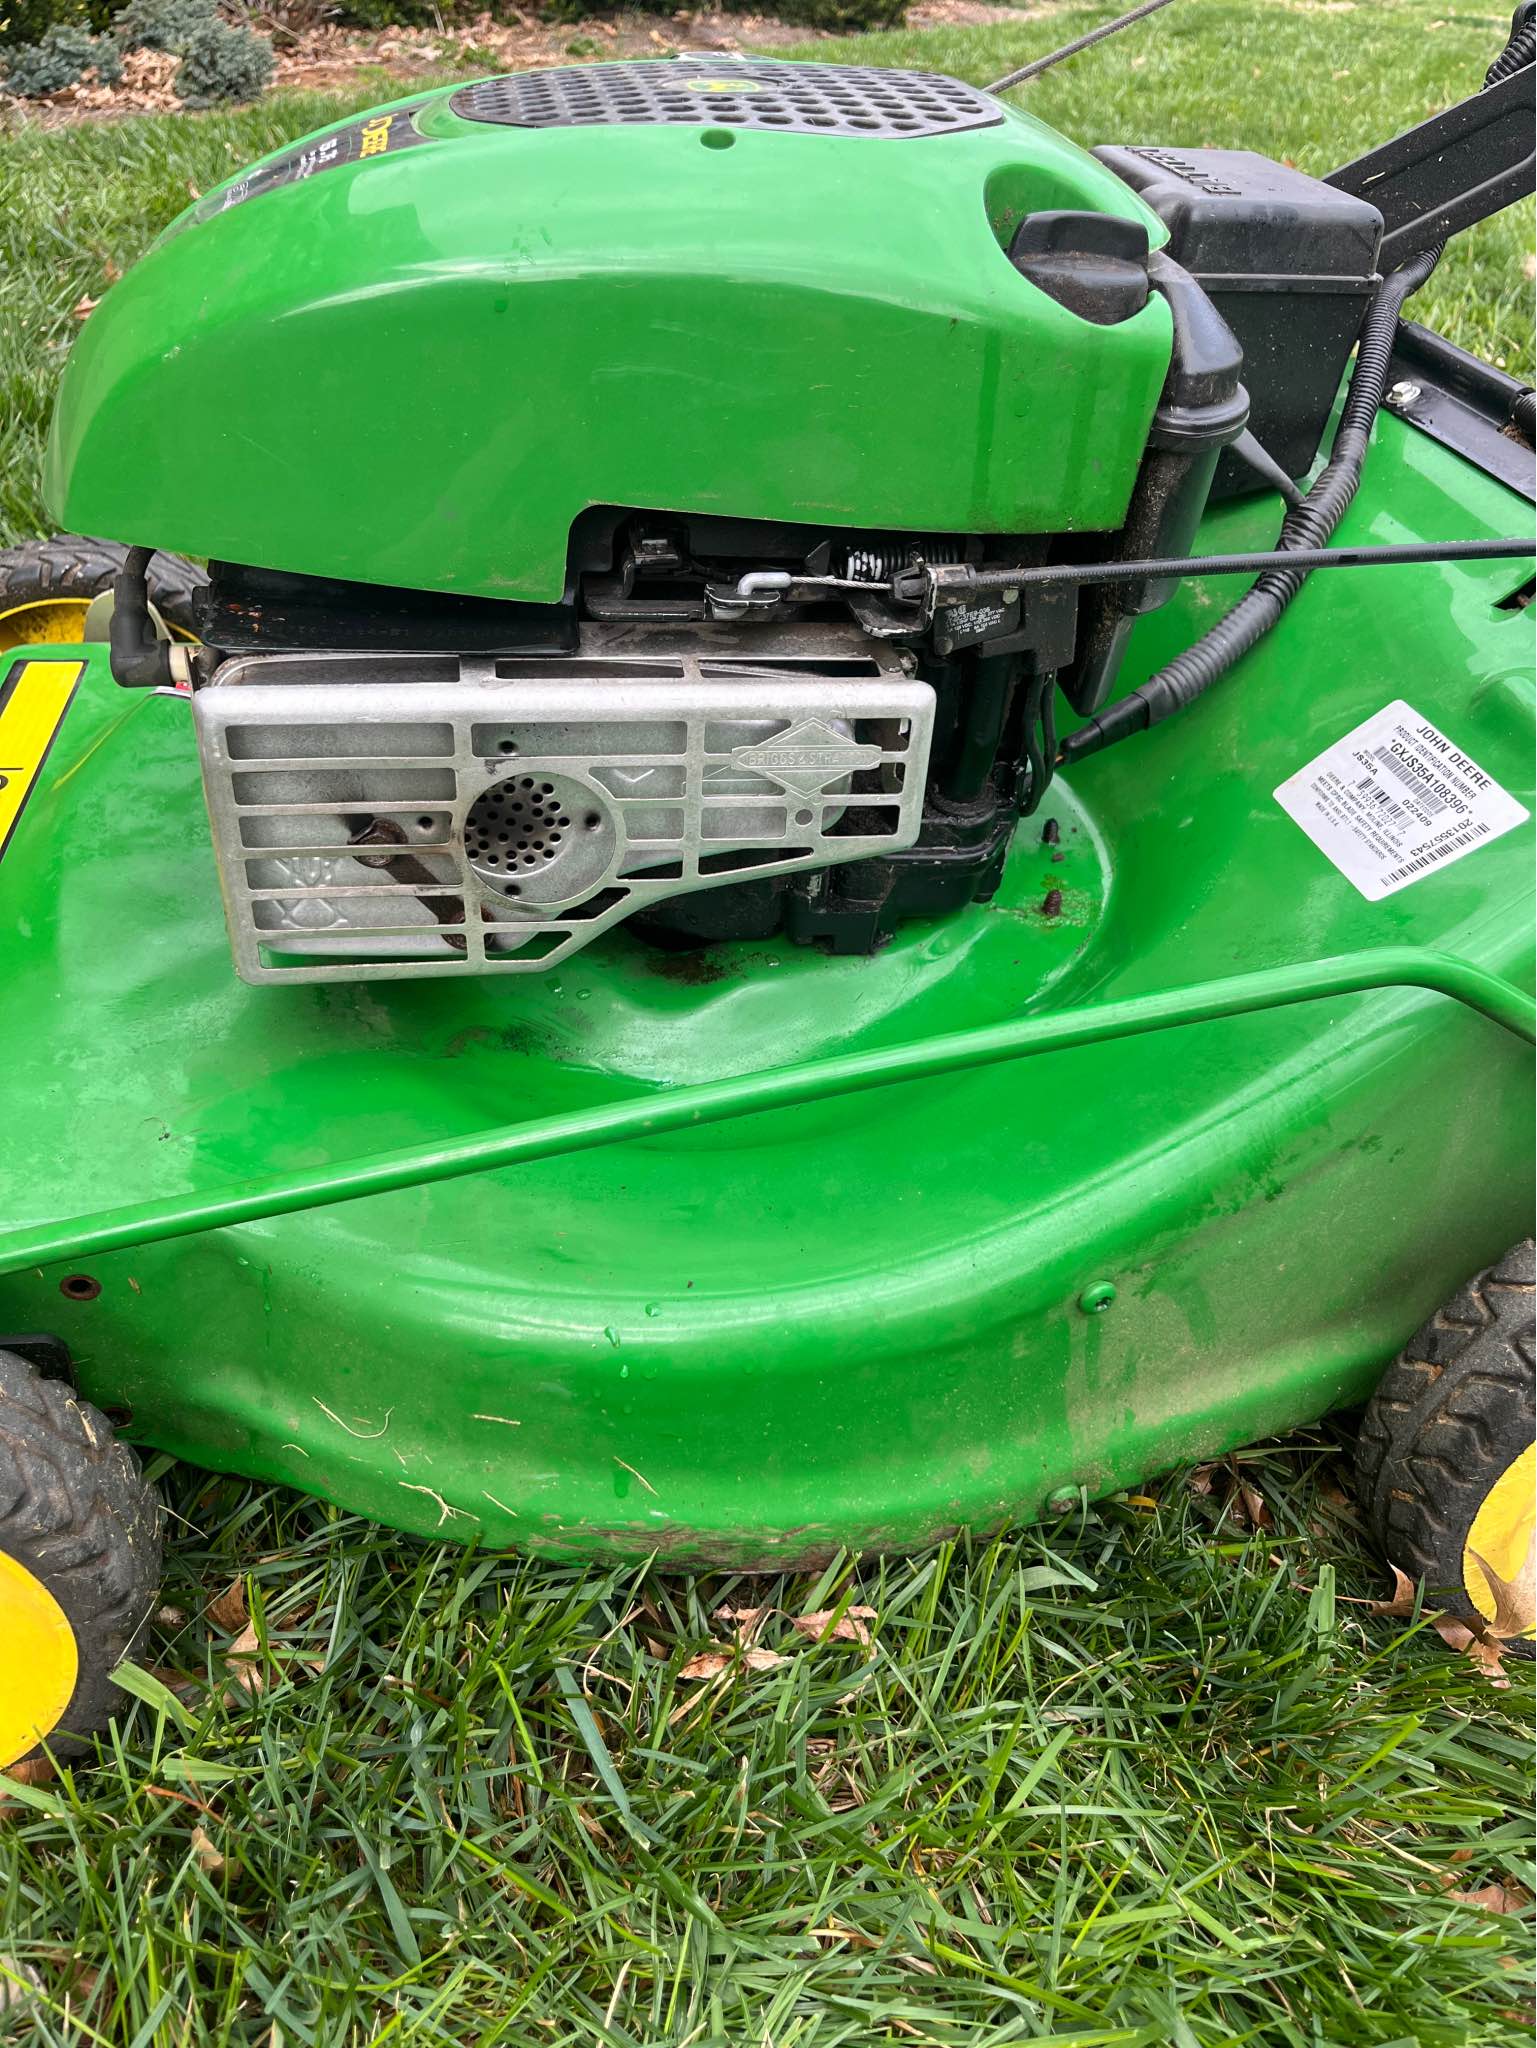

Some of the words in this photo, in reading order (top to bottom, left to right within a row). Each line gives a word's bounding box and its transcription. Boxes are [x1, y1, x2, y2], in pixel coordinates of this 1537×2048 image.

[748, 752, 797, 765] BRIGGS
[1350, 749, 1379, 776] JS35A
[1393, 724, 1418, 746] PRODUCT
[1413, 743, 1455, 779] IDENTIFICATION
[1448, 776, 1478, 800] NUMBER
[1414, 723, 1451, 754] JOHN
[1446, 752, 1493, 791] DEERE
[1316, 775, 1333, 791] MEETS
[1354, 814, 1373, 831] SAFETY
[1369, 830, 1405, 863] REQUIREMENTS
[1356, 789, 1378, 810] 59936
[1373, 808, 1396, 828] 72027
[1400, 798, 1433, 827] 022409
[1382, 828, 1403, 847] ILLINOIS
[1409, 817, 1473, 857] 2013557543
